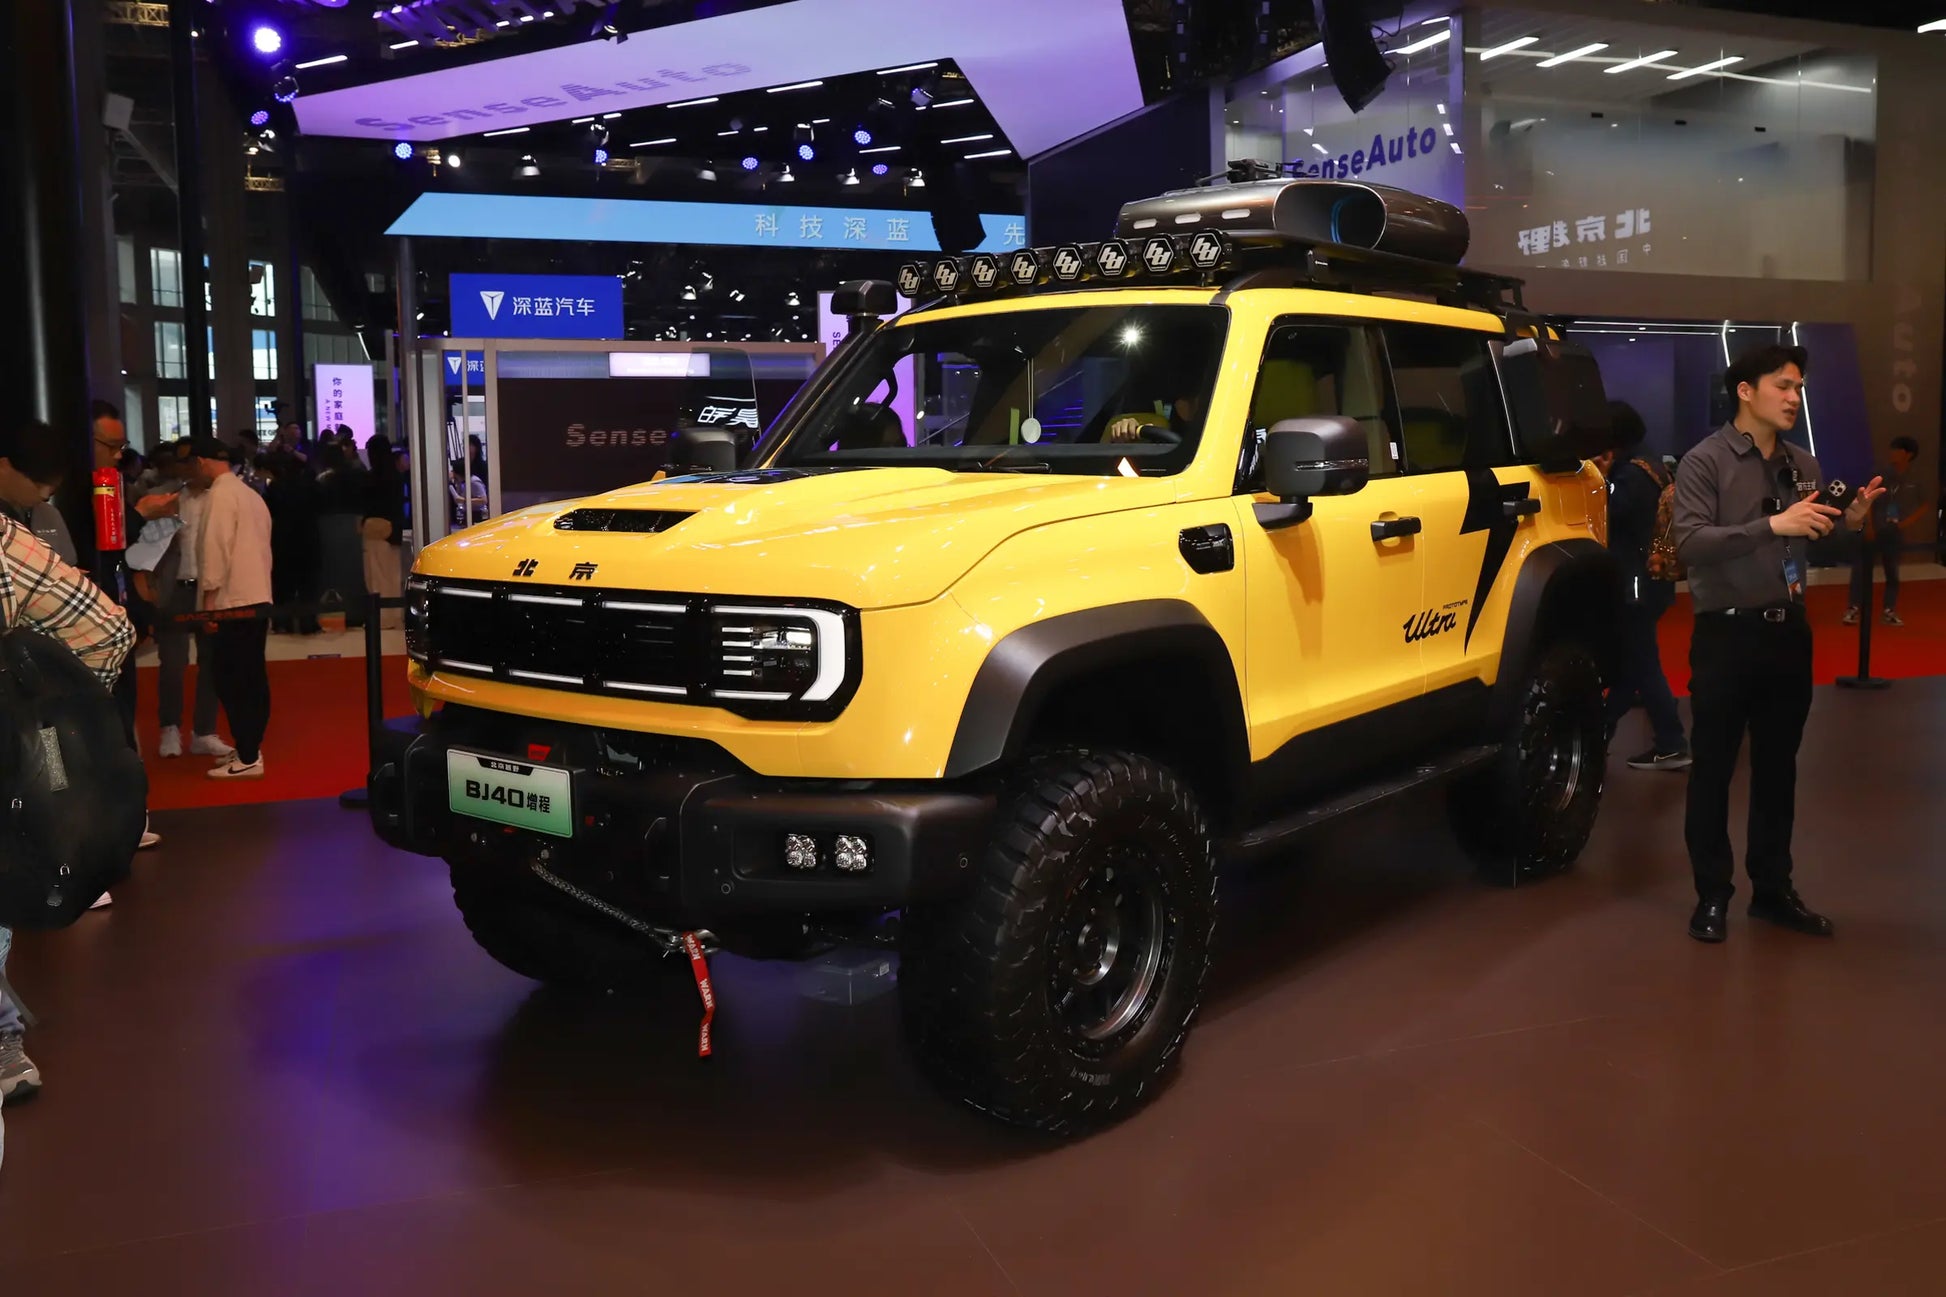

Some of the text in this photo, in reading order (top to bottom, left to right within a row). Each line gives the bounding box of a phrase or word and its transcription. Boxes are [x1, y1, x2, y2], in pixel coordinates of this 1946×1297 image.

[354, 62, 752, 132] SenseAuto
[755, 213, 1025, 246] 科技深蓝 先
[512, 296, 595, 316] 深蓝汽车
[832, 331, 841, 346] SE
[566, 423, 668, 448] Sense
[512, 558, 599, 580] 北京
[686, 934, 701, 960] WARN
[700, 978, 714, 1009] WARN
[701, 1023, 709, 1052] WARN
